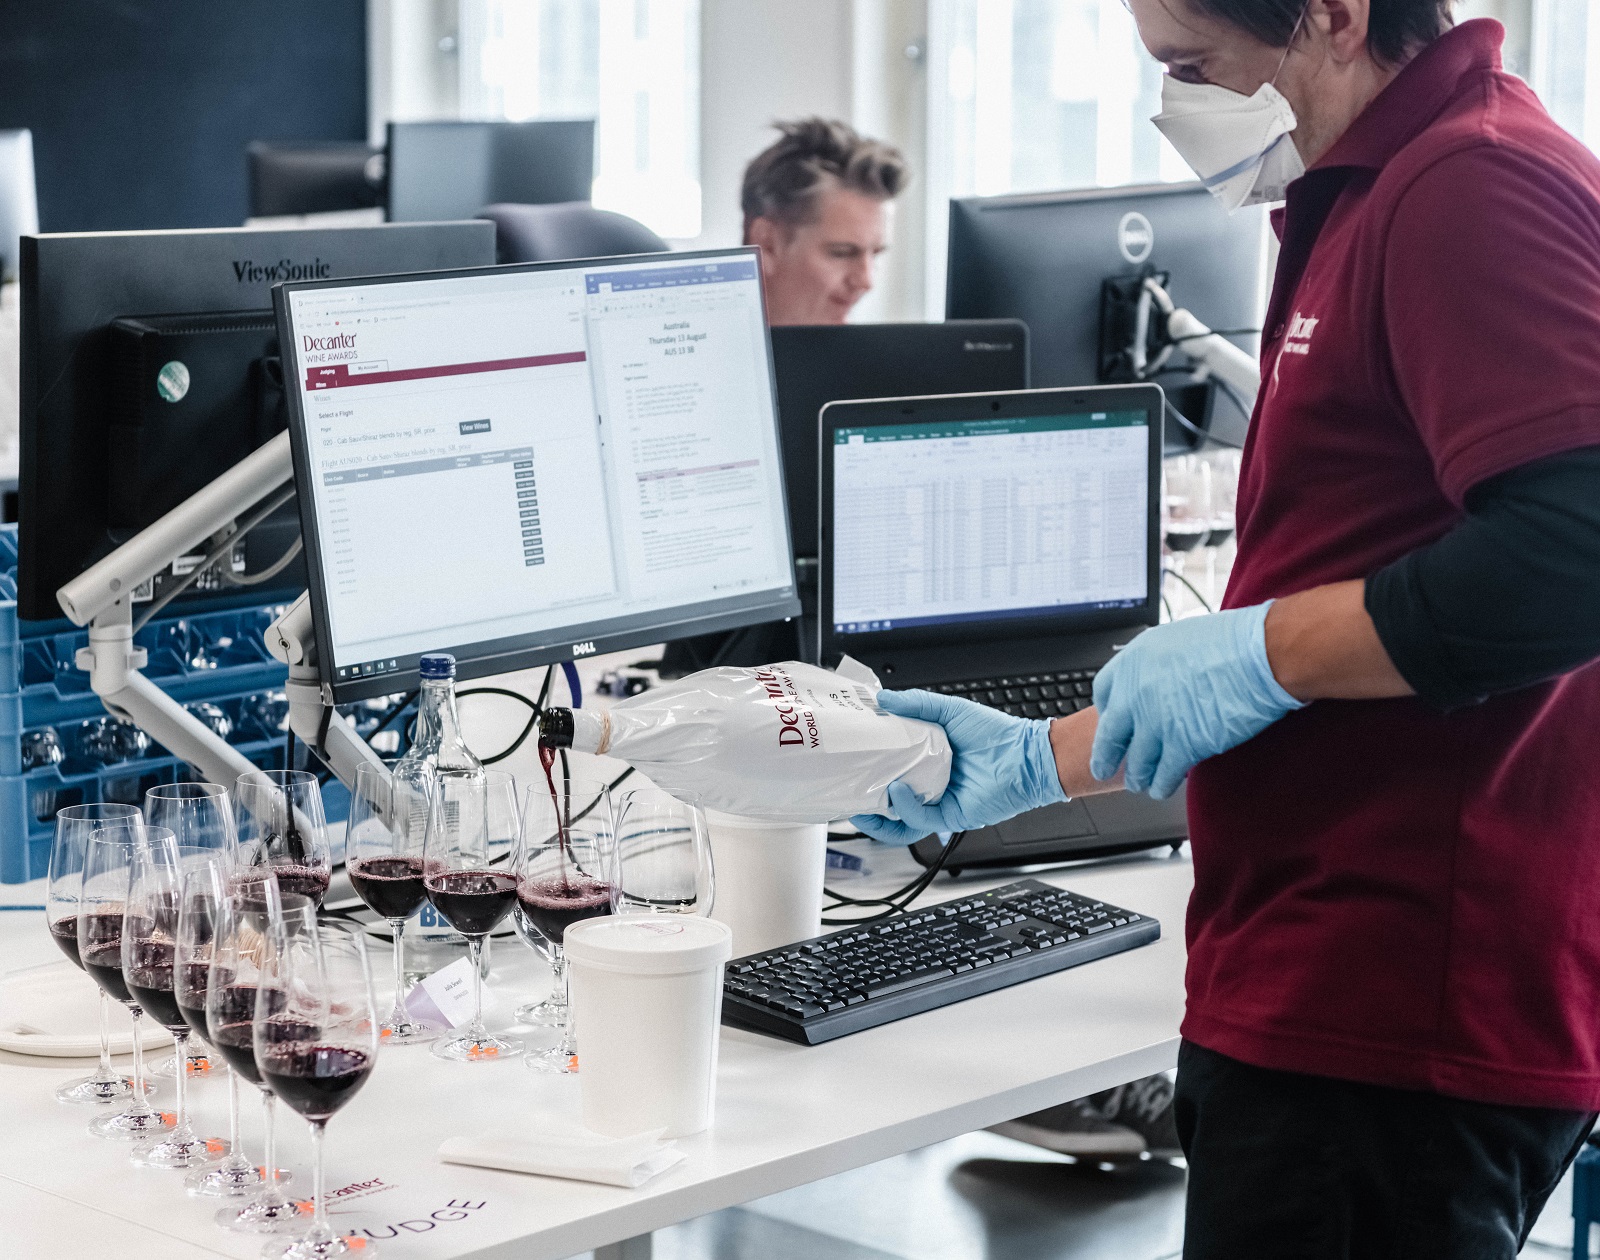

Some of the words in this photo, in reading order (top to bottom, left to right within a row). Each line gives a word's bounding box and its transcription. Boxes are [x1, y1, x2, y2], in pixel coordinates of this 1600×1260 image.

[232, 257, 330, 282] ViewSonic
[663, 321, 690, 330] Australia
[303, 332, 357, 352] Decanter
[649, 335, 676, 344] Thursday
[687, 333, 707, 342] August
[305, 353, 326, 363] WINE
[327, 351, 358, 362] AWARDS
[664, 347, 677, 356] AUS
[318, 411, 334, 419] Select
[339, 410, 354, 418] Flight
[474, 422, 489, 430] Wines
[572, 641, 596, 656] DELL
[804, 711, 820, 749] WORLD
[350, 1199, 487, 1240] UDGE
